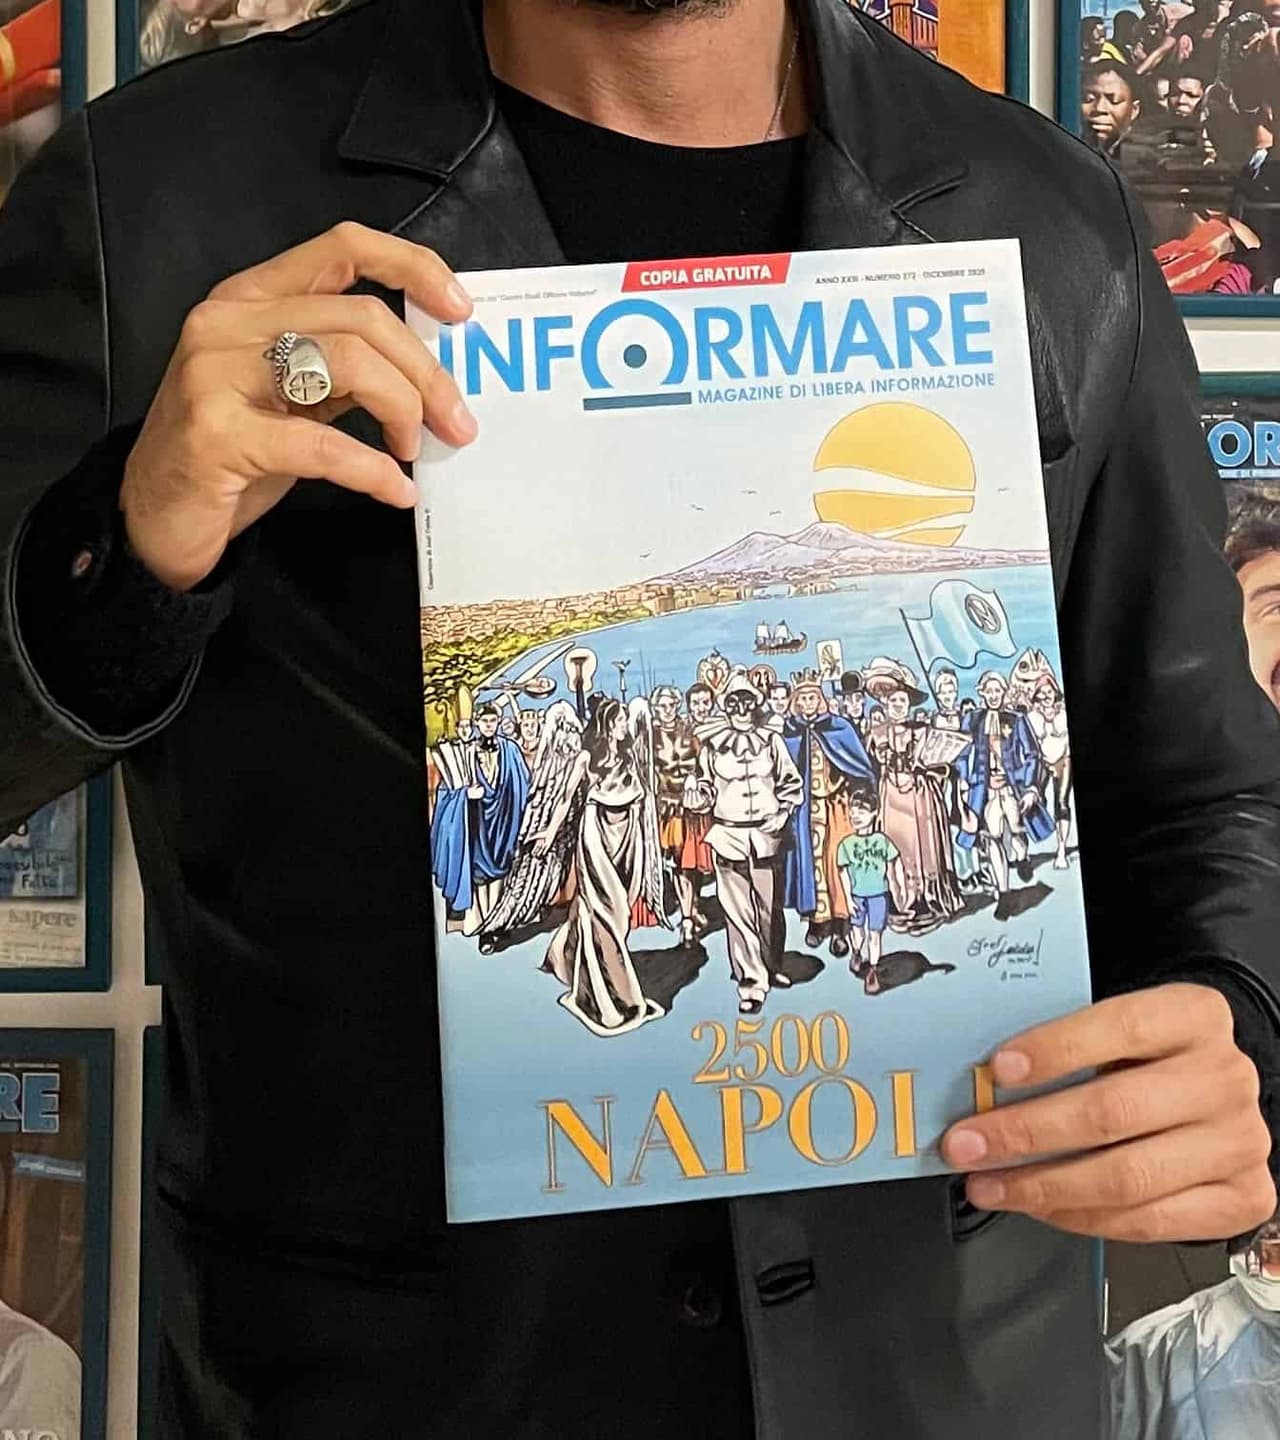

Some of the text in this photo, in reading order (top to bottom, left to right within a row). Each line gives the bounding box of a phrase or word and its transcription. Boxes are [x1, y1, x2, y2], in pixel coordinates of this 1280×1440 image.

[639, 264, 772, 287] COPIA GRATUITA
[439, 291, 994, 395] INFORMARE
[698, 372, 995, 405] MAGAZINE DI LIBERA INFORMAZIONE
[691, 1010, 852, 1085] 2500
